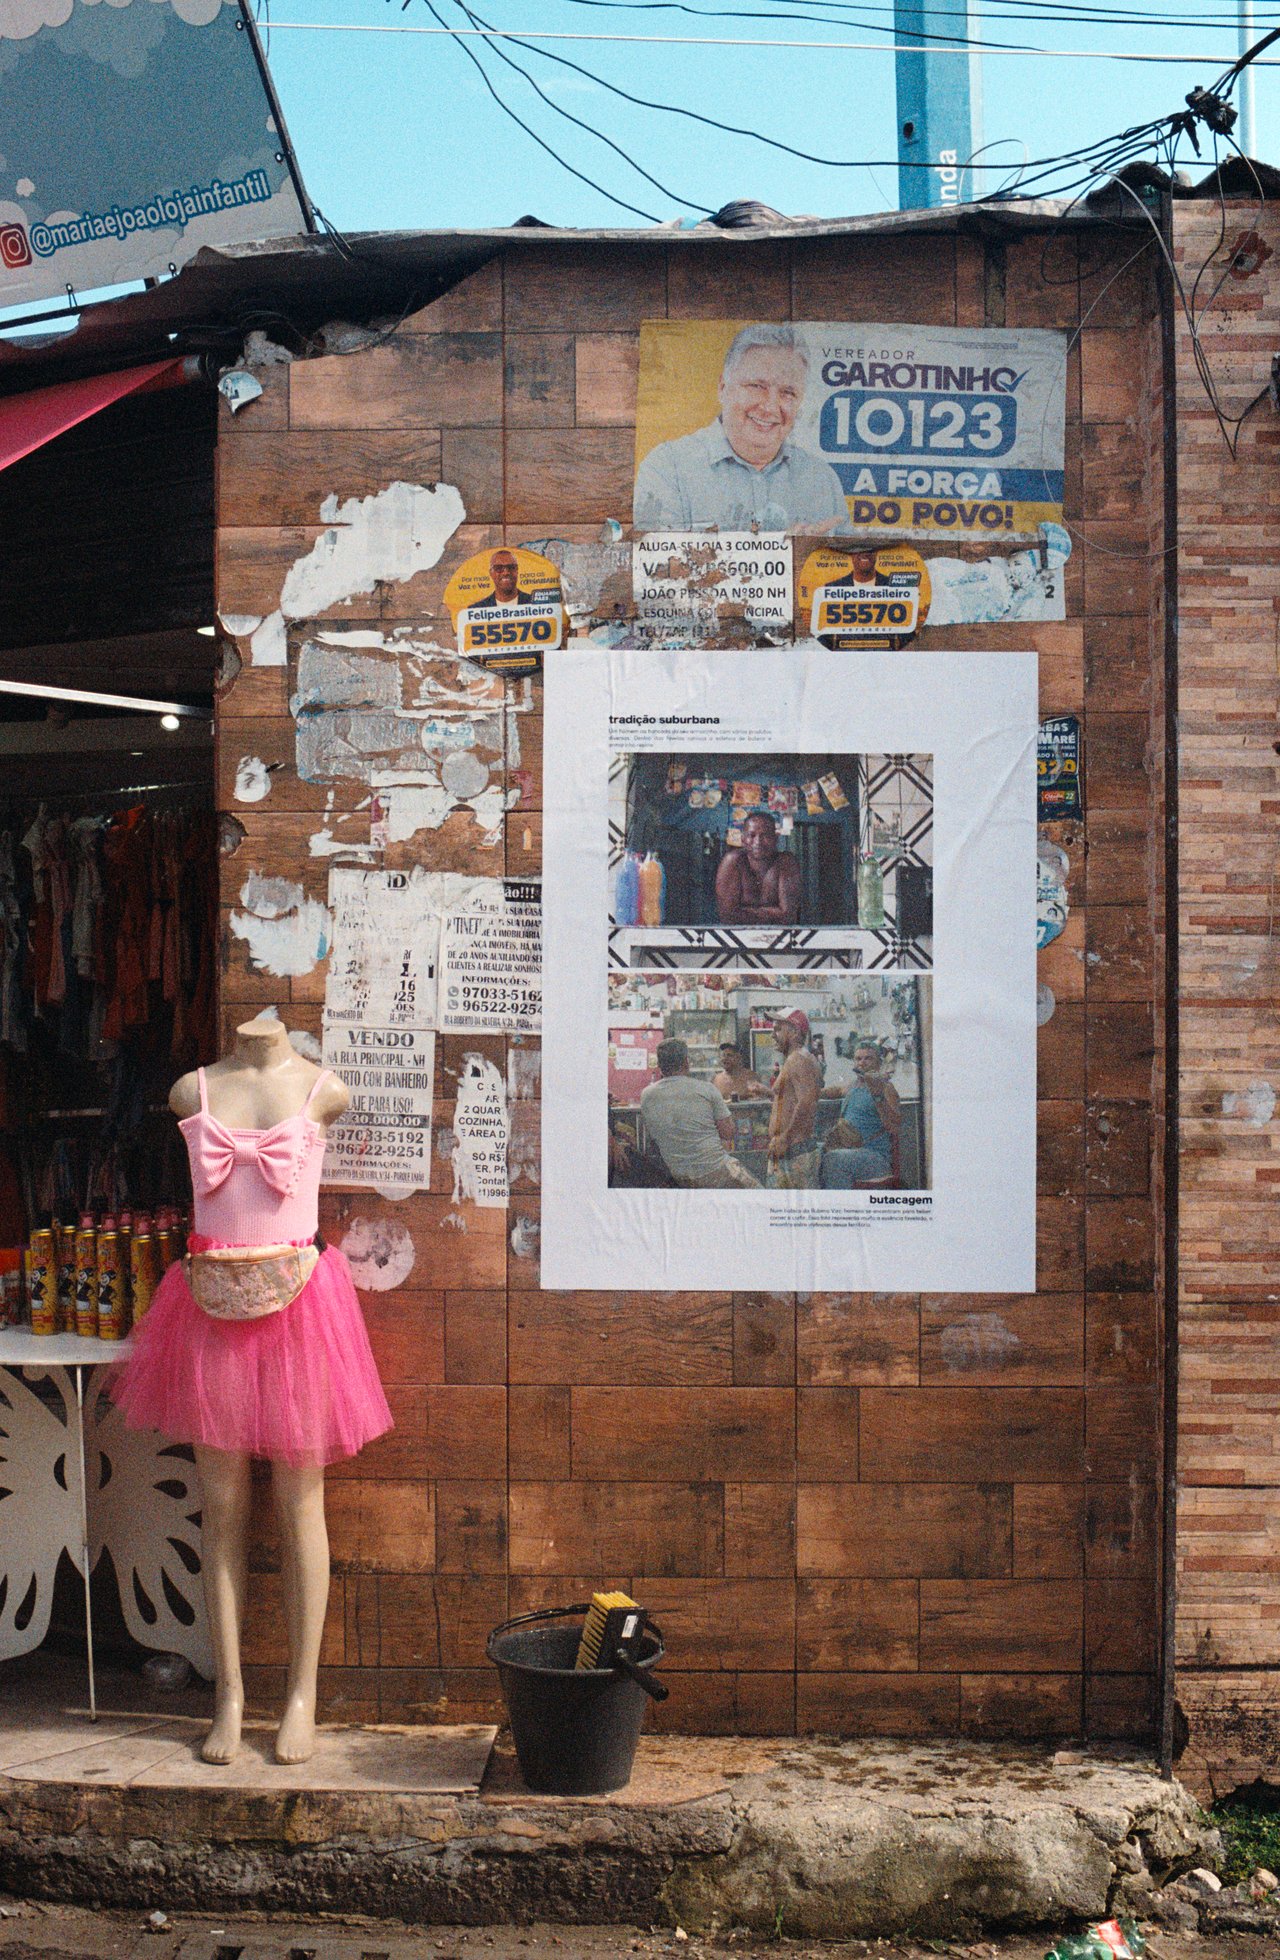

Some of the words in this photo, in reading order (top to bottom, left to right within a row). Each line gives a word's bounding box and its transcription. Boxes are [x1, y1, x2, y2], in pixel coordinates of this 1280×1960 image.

[935, 149, 957, 207] nda
[32, 170, 269, 255] @mariaejoaolojainfantil
[822, 348, 915, 361] VEREADOR
[821, 360, 1020, 393] GAROTINHO
[833, 397, 1003, 450] 10123
[853, 468, 878, 493] A
[888, 469, 1003, 501] FORÇA
[853, 500, 902, 525] DO
[912, 502, 1014, 529] POVO!
[726, 541, 733, 550] 3
[641, 585, 676, 601] JOÃO
[767, 586, 787, 599] NH
[826, 603, 907, 624] 55570
[471, 620, 552, 646] 55570
[608, 715, 657, 726] tradição
[659, 715, 720, 725] suburbana
[505, 886, 535, 899] ão!!!
[470, 952, 489, 961] ANOS
[447, 961, 476, 971] CLIENTES
[483, 962, 513, 972] REALIZAR
[348, 1030, 415, 1048] VENDO
[340, 1051, 358, 1064] RUA
[360, 1052, 405, 1067] PRINCIPAL
[413, 1054, 426, 1067] NH
[363, 1071, 383, 1087] COM
[384, 1072, 429, 1090] BANHEIRO
[368, 1095, 391, 1113] PARA
[393, 1096, 414, 1114] USO!
[463, 1105, 470, 1113] 2
[472, 1106, 504, 1116] QUAR
[458, 1117, 507, 1128] COZINHA,
[468, 1127, 497, 1138] ÁREA
[340, 1159, 412, 1170] INFORMAÇÕES:
[870, 1194, 933, 1206] butacagem
